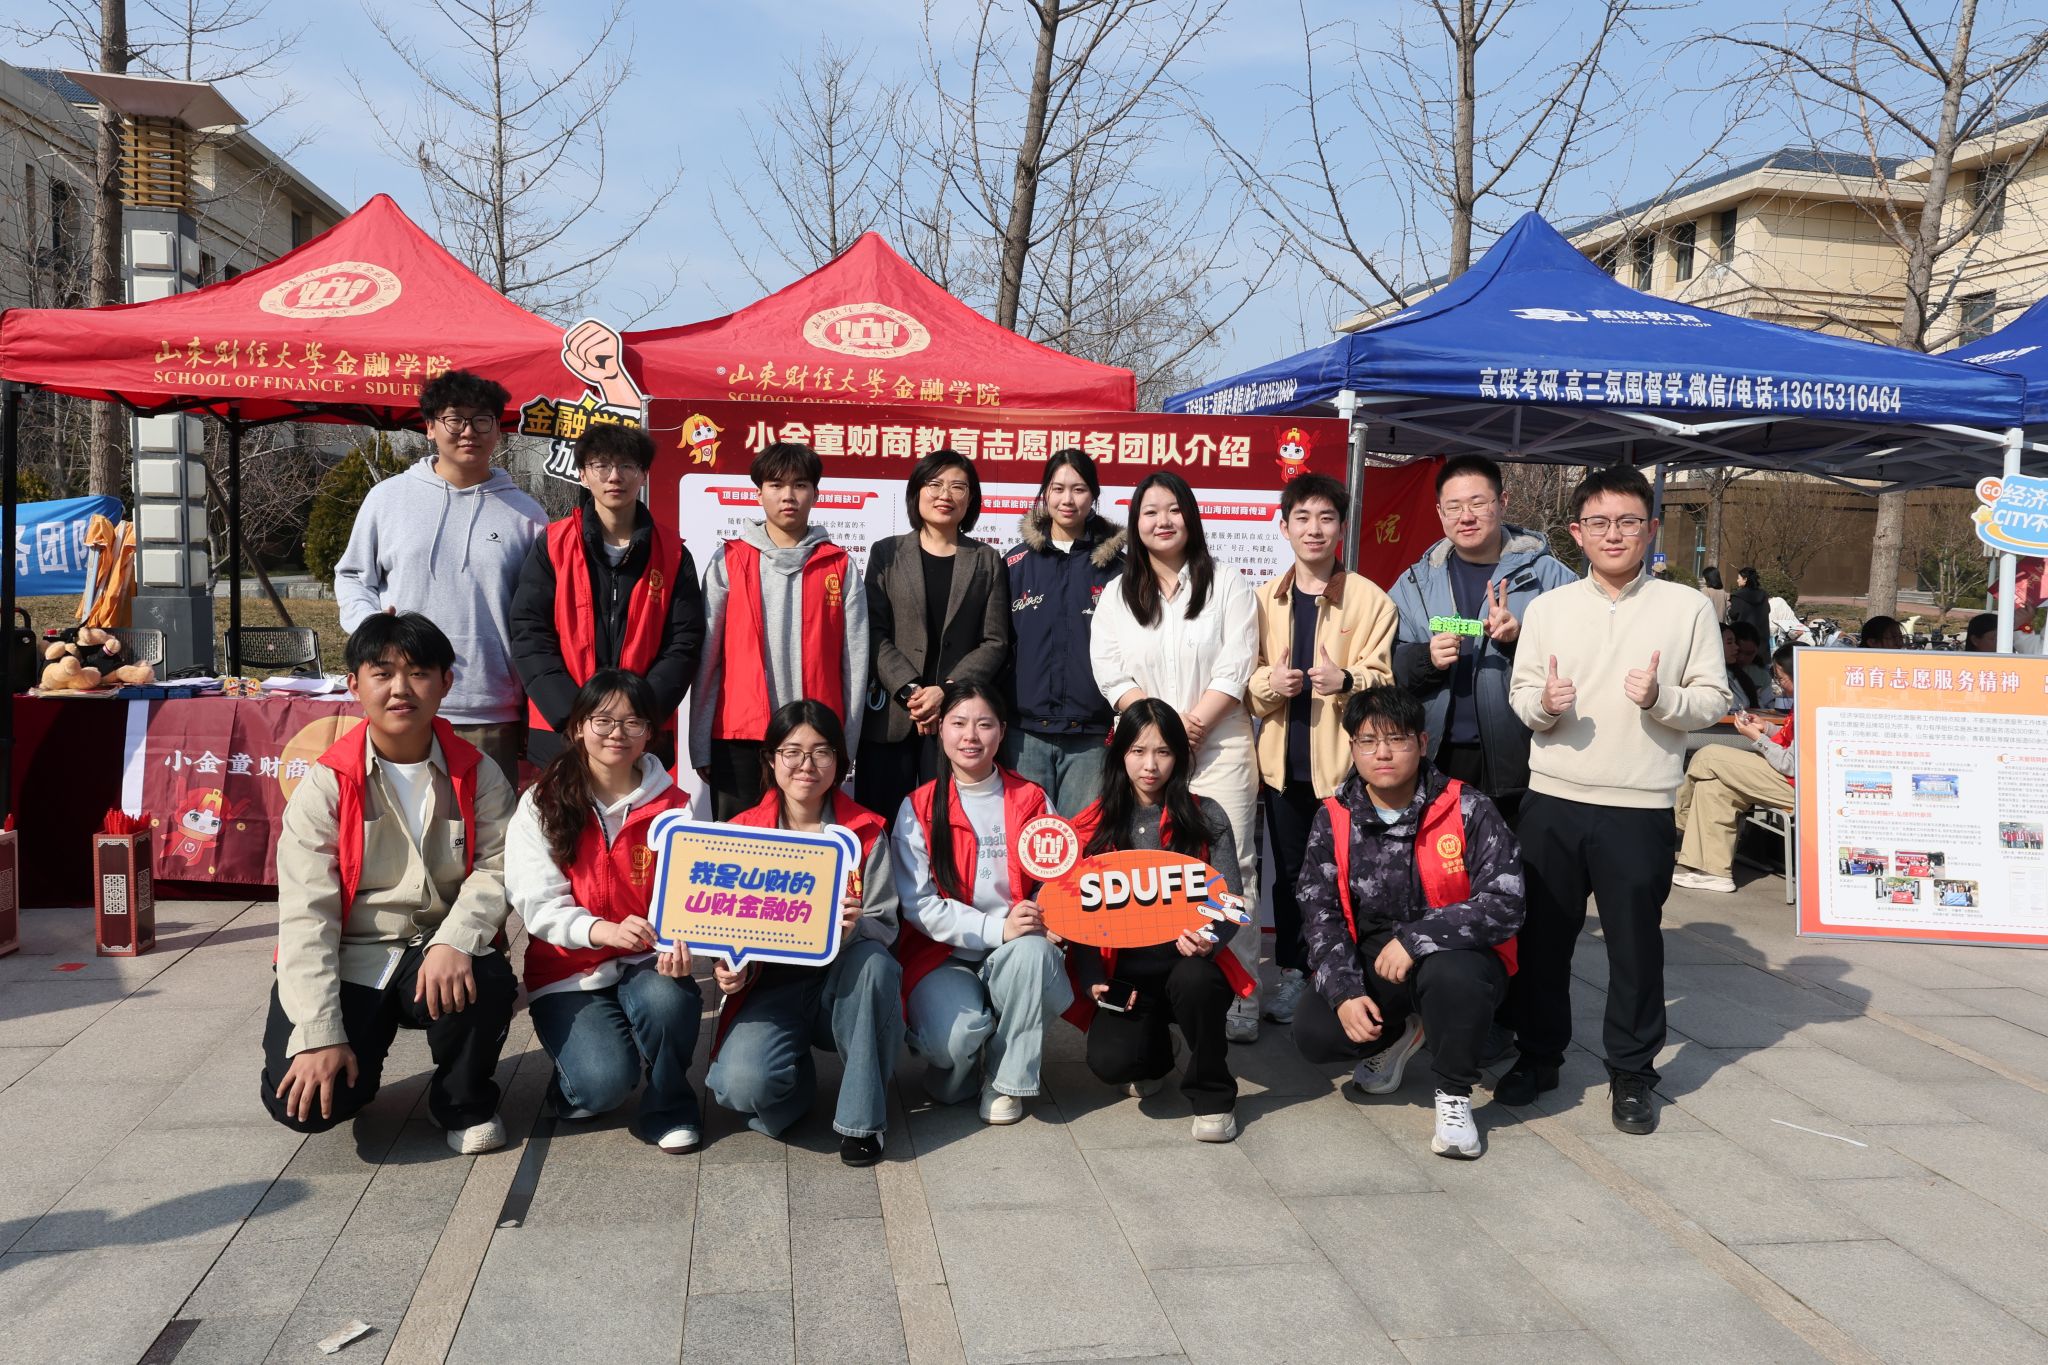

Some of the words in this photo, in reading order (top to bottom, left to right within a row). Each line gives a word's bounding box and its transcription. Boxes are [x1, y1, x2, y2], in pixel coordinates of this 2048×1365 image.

[154, 370, 231, 387] SCHOOL
[234, 374, 259, 388] OF
[264, 376, 345, 393] FINANCE
[745, 421, 1250, 467] 小金童财商教育志愿服务团队介绍
[1982, 484, 2000, 497] GO
[1844, 665, 2021, 694] 涵育志愿服务精神
[164, 749, 311, 780] 小金童财商
[689, 861, 816, 896] 我是山财的
[1079, 863, 1209, 912] SDUFE
[684, 890, 813, 924] 山财金融的
